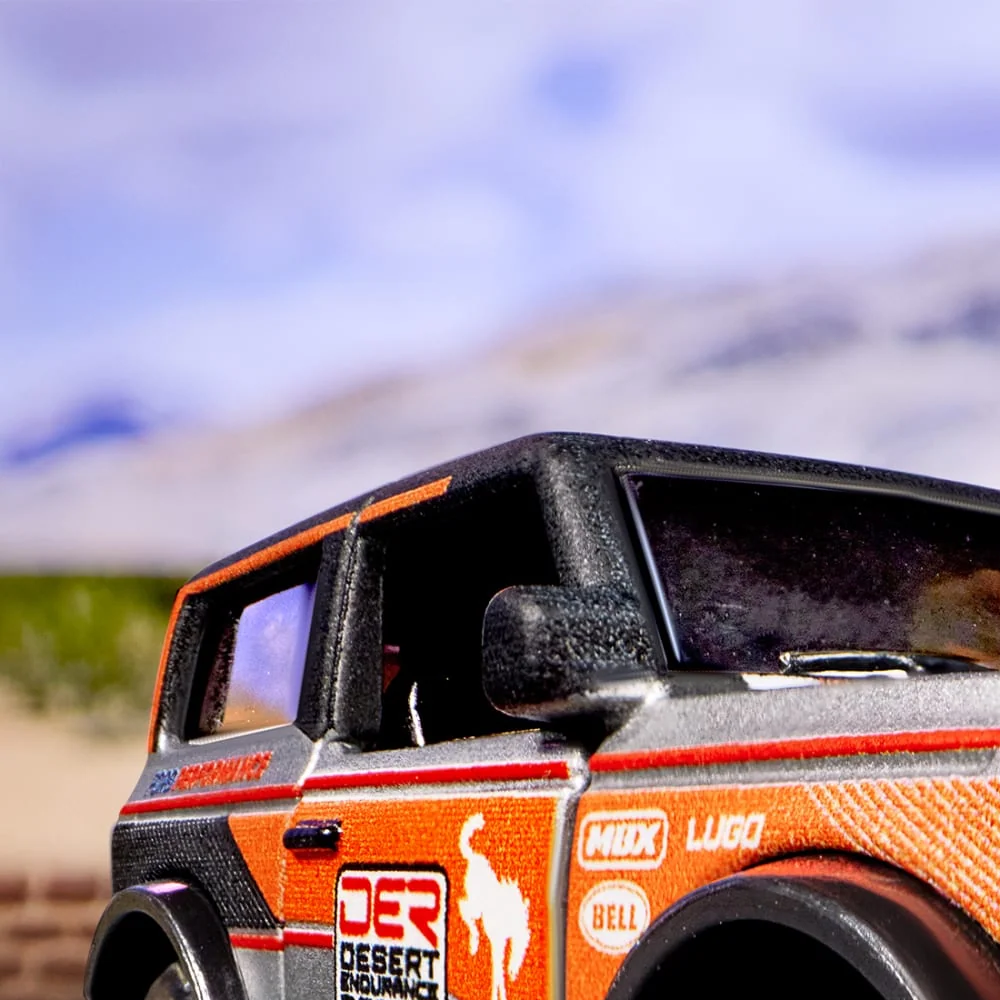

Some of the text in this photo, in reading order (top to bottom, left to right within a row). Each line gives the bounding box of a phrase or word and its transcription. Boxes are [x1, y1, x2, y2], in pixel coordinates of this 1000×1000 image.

[585, 823, 662, 857] MBX
[685, 813, 767, 851] LUGO
[338, 876, 441, 949] DER
[592, 903, 638, 931] BELL
[339, 941, 440, 979] DESERT
